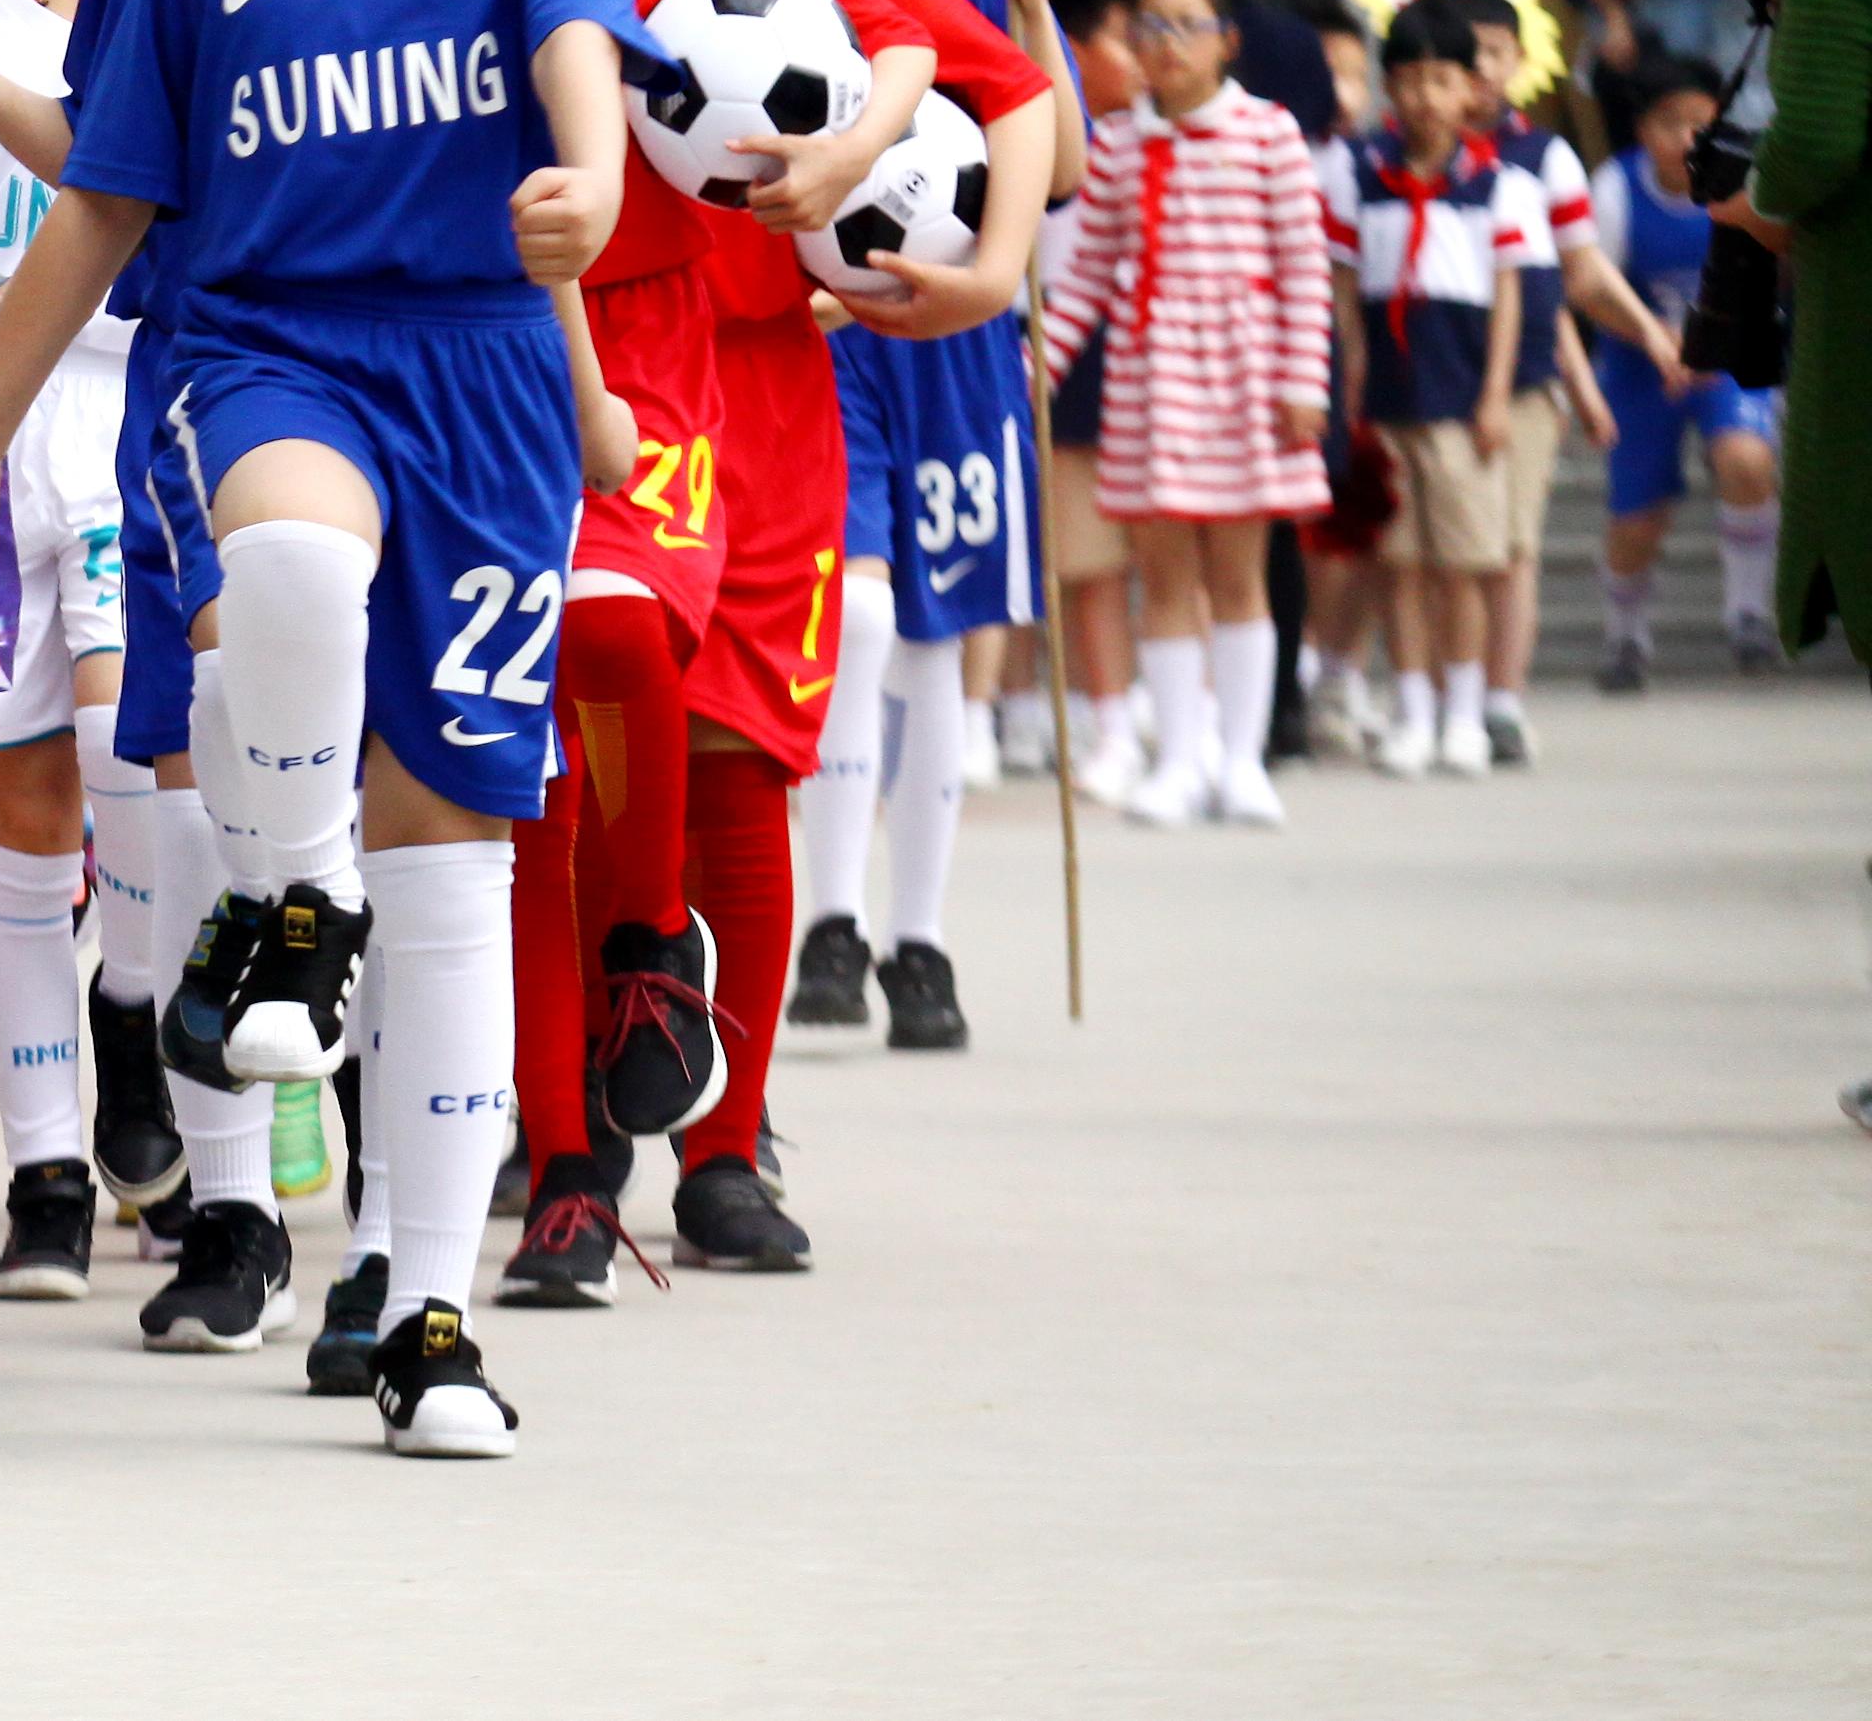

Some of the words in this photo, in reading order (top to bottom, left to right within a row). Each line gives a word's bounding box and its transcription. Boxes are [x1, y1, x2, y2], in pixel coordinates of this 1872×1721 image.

[227, 31, 508, 159] SUNING
[629, 434, 714, 536] 29
[915, 451, 999, 554] 33
[431, 564, 564, 707] 22
[247, 744, 337, 772] CFC
[428, 1088, 508, 1116] CFC
